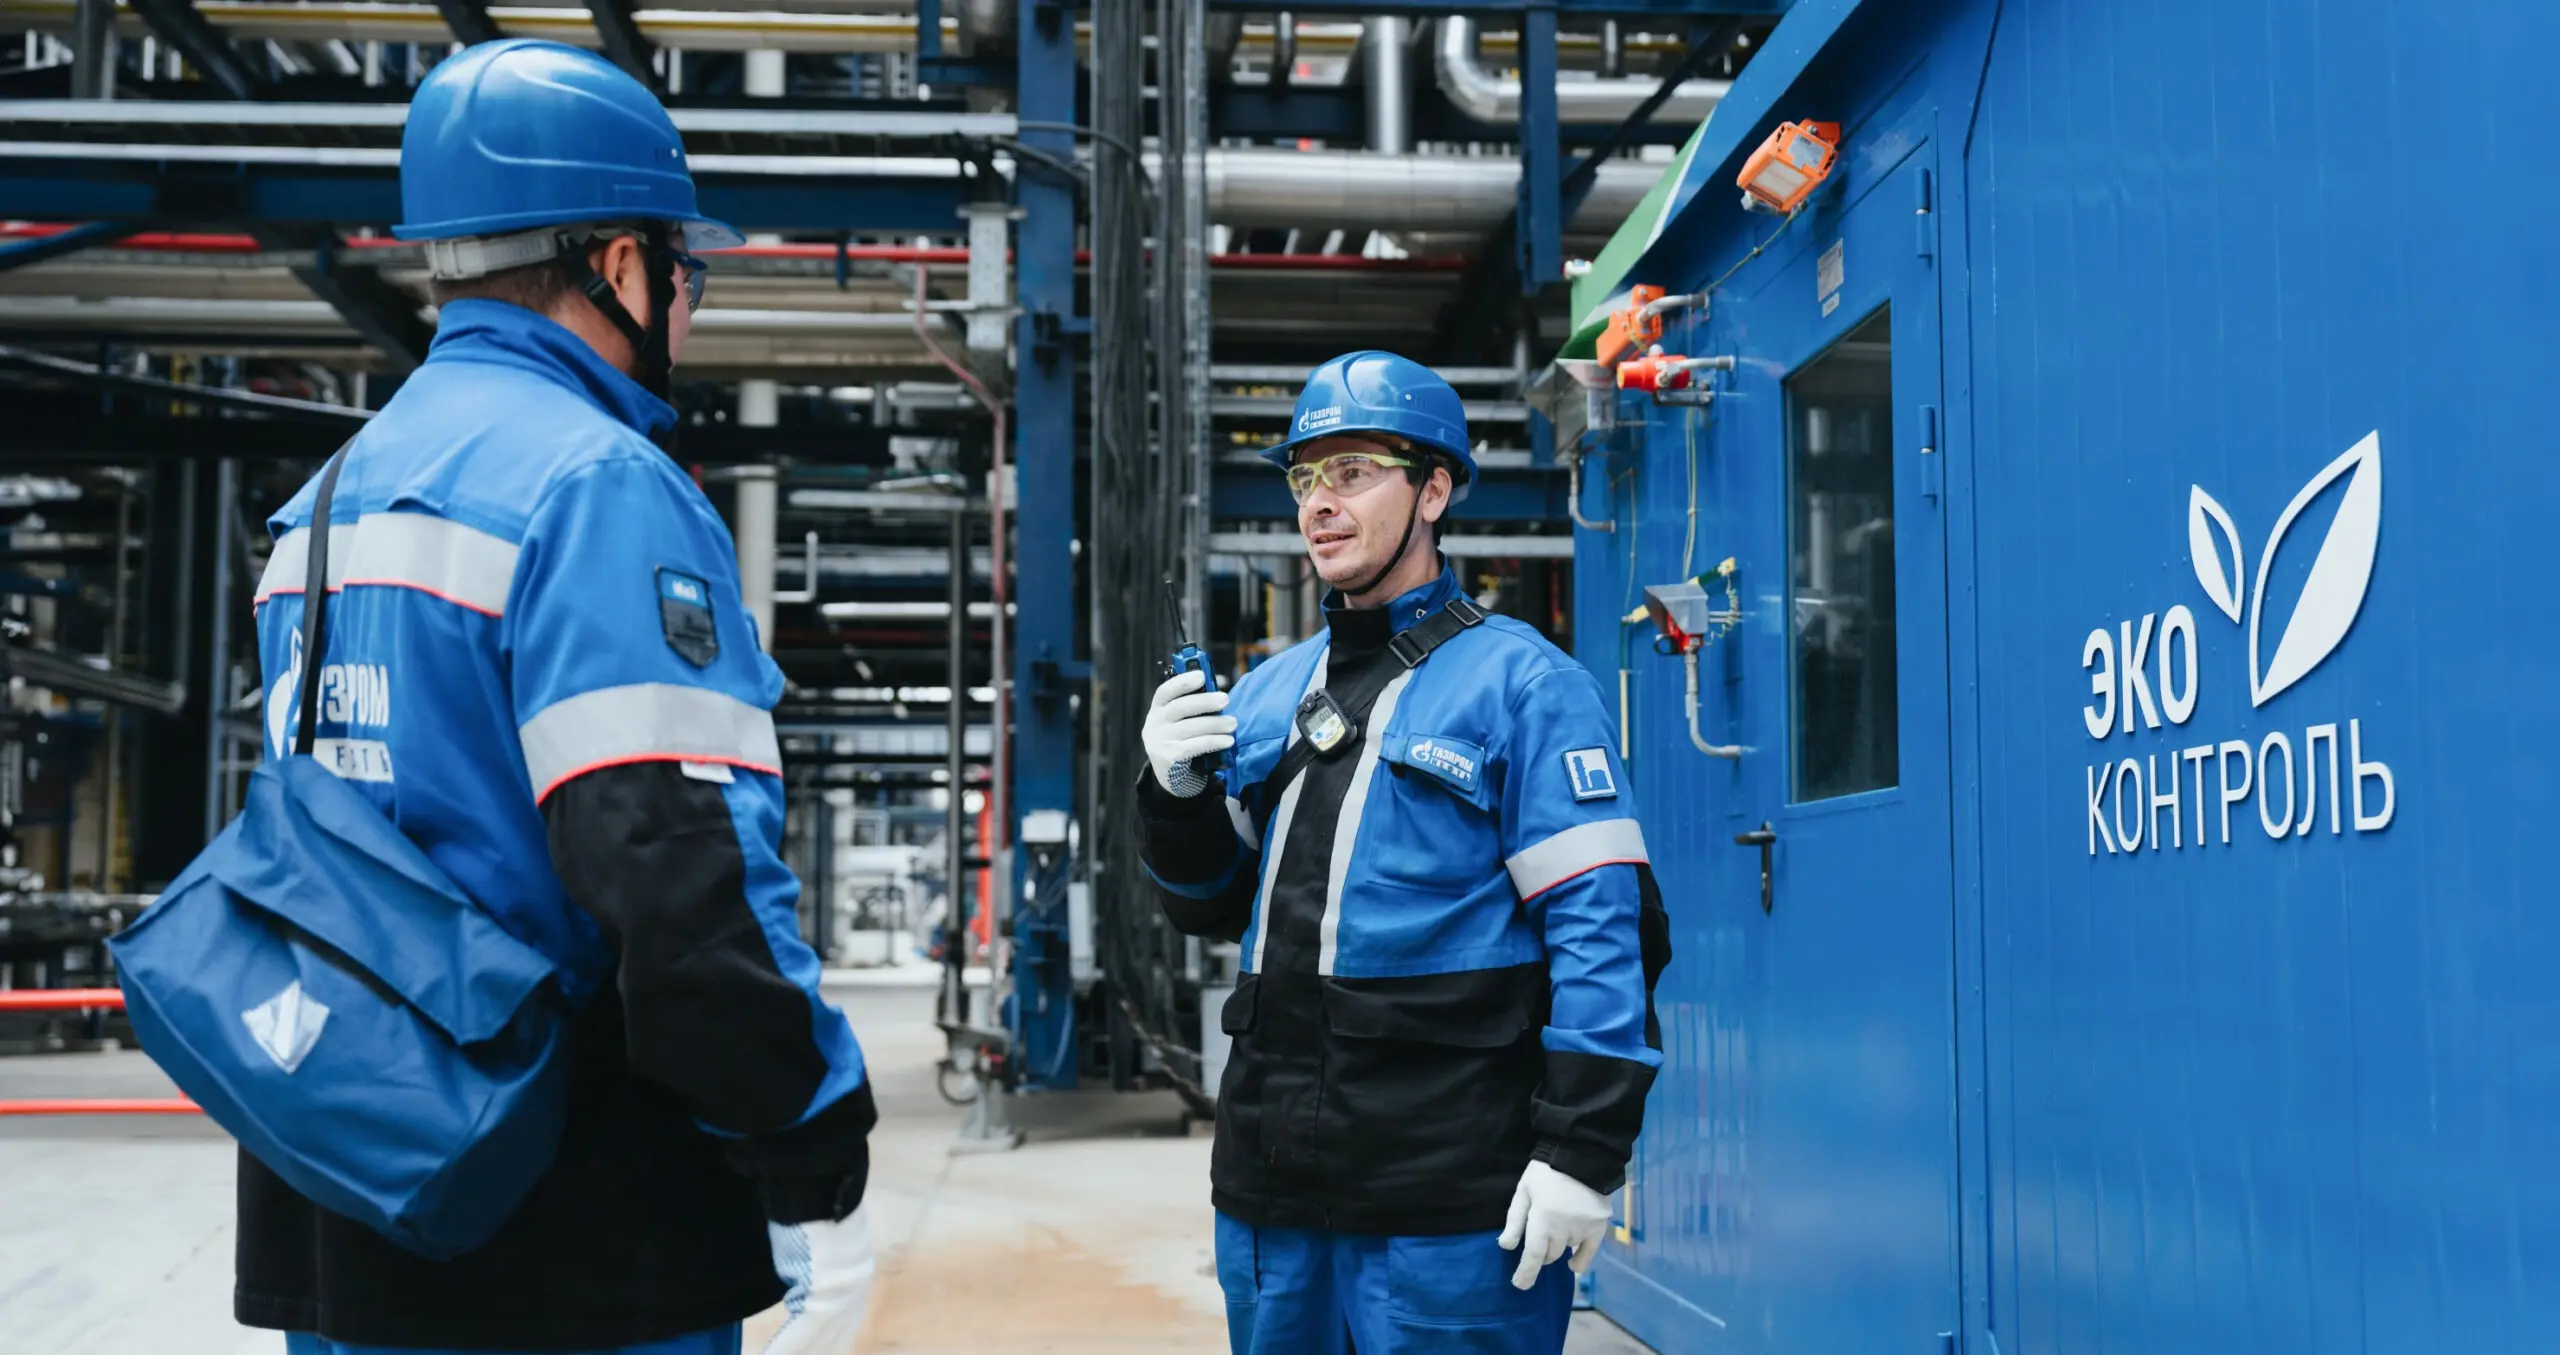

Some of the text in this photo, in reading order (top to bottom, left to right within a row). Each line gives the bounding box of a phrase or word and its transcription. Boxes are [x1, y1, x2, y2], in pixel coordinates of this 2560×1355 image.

[2082, 604, 2199, 738] ЭКО
[1432, 746, 1475, 773] ГАЗПРОМ
[2087, 718, 2396, 855] КОНТРОЛЬ
